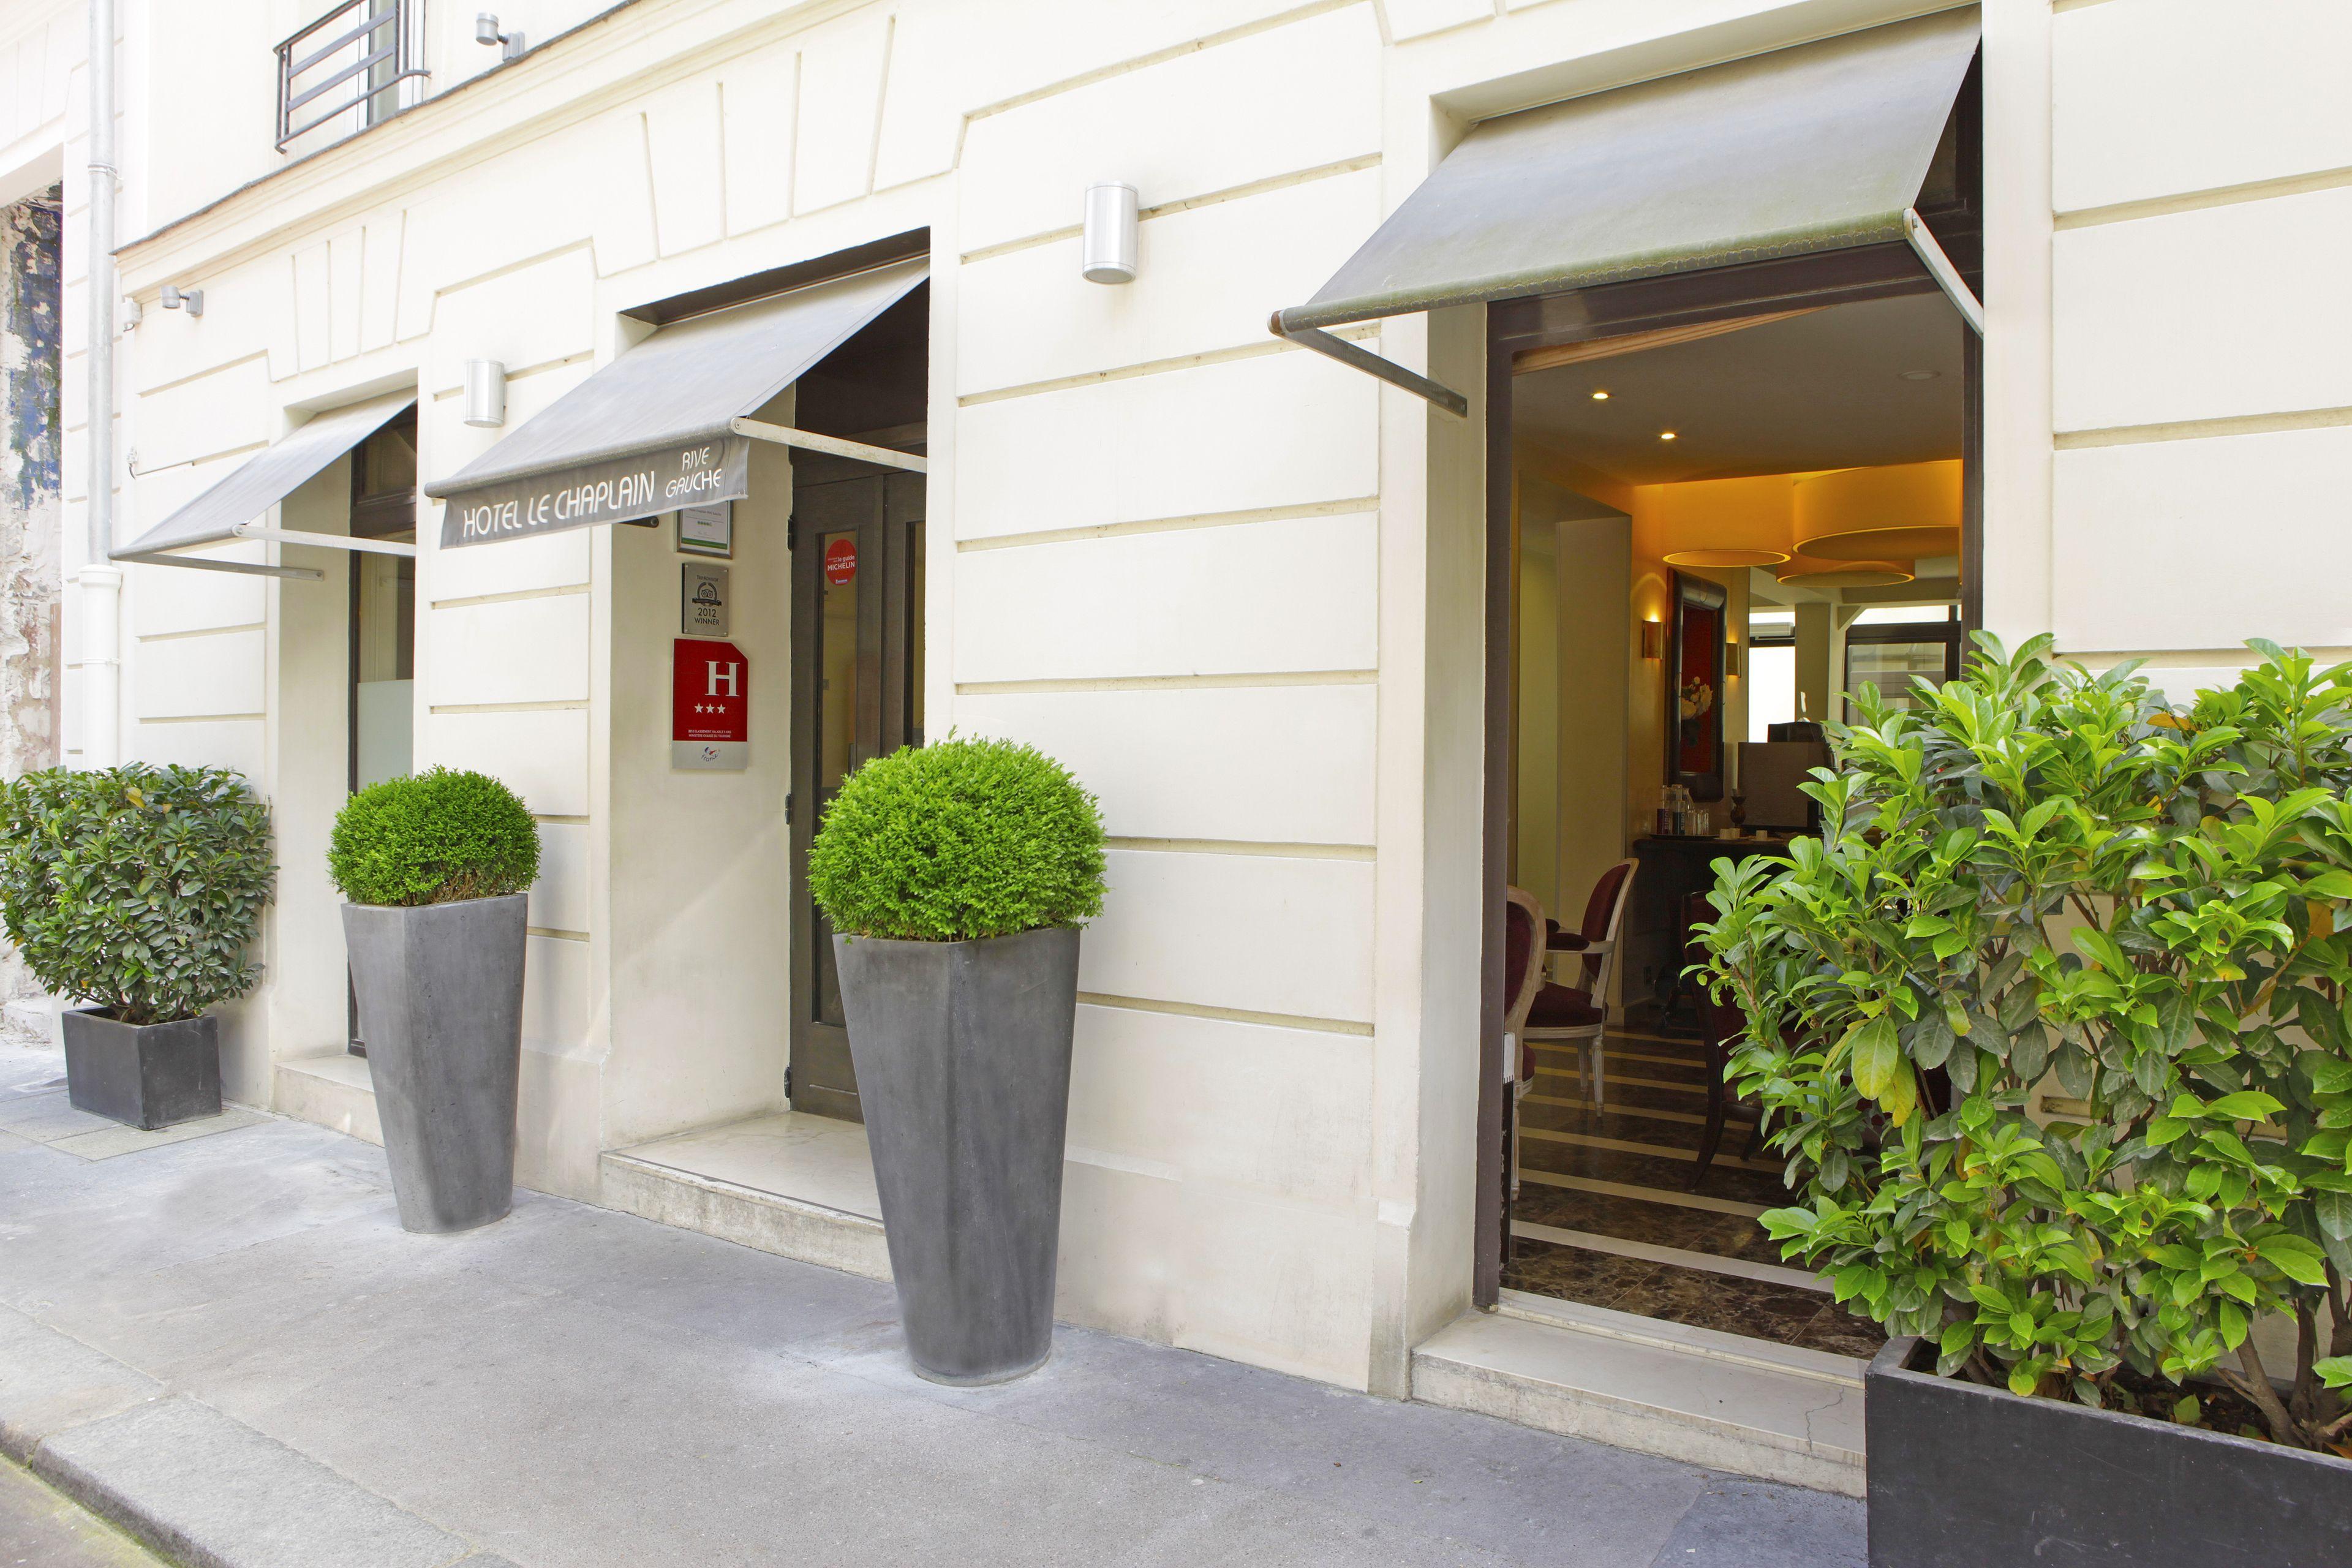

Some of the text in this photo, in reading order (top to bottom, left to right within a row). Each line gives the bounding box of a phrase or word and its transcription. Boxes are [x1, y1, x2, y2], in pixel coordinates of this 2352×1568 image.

[682, 447, 710, 471] RIVE
[665, 468, 722, 498] GAUCHE
[463, 470, 655, 537] HOTEL LE CHAPLAIN
[827, 561, 855, 571] MICHELIN
[694, 617, 720, 625] WINNER
[698, 607, 717, 617] 2012
[705, 660, 741, 697] H
